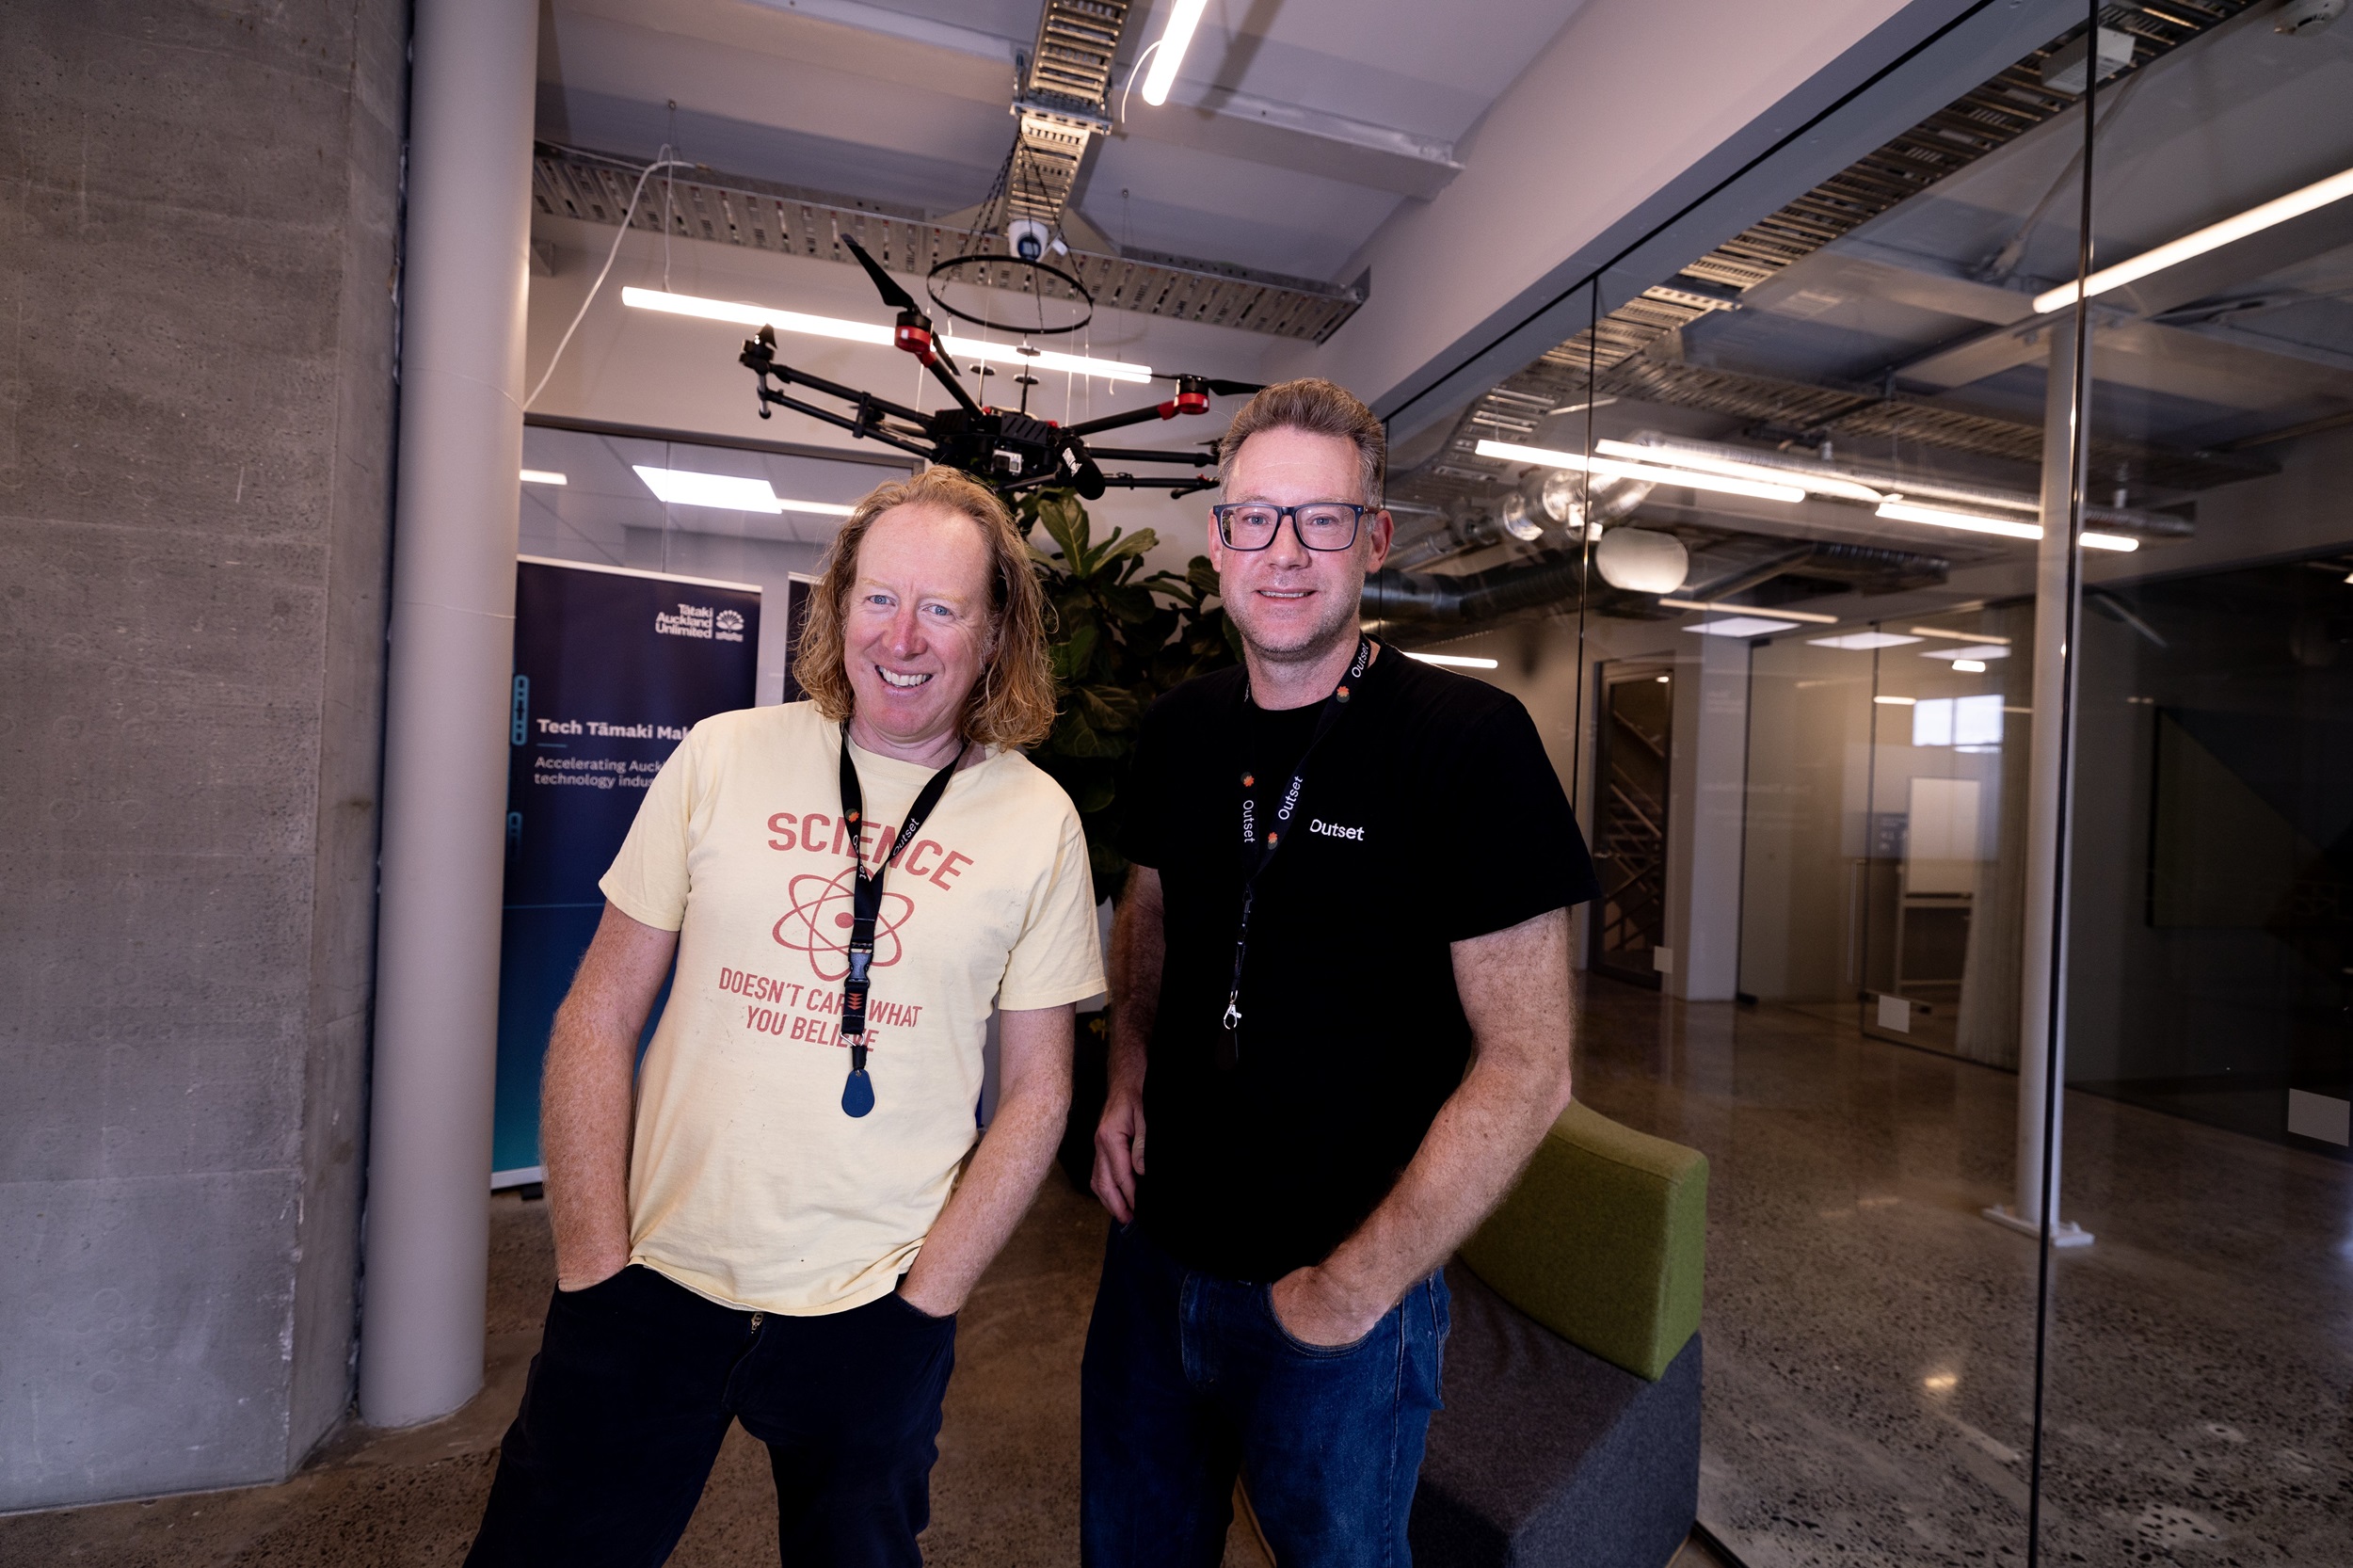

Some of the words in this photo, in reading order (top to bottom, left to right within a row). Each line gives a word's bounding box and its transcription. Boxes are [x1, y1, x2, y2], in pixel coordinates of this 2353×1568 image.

[655, 622, 713, 639] Unlimited
[656, 611, 713, 629] Auckland
[1351, 642, 1369, 678] Outset
[536, 718, 583, 735] Tech
[657, 726, 692, 741] Mak
[534, 773, 616, 790] technology
[535, 756, 627, 774] Accelerating
[629, 760, 664, 773] Auck
[1277, 776, 1304, 821] Outset
[892, 817, 920, 856] Outset
[1242, 799, 1256, 843] Outset
[767, 812, 974, 892] SCIENCE
[718, 967, 805, 1007] DOESN'T
[806, 988, 845, 1016] CAR
[868, 999, 922, 1028] WHAT
[746, 1004, 788, 1035] YOU
